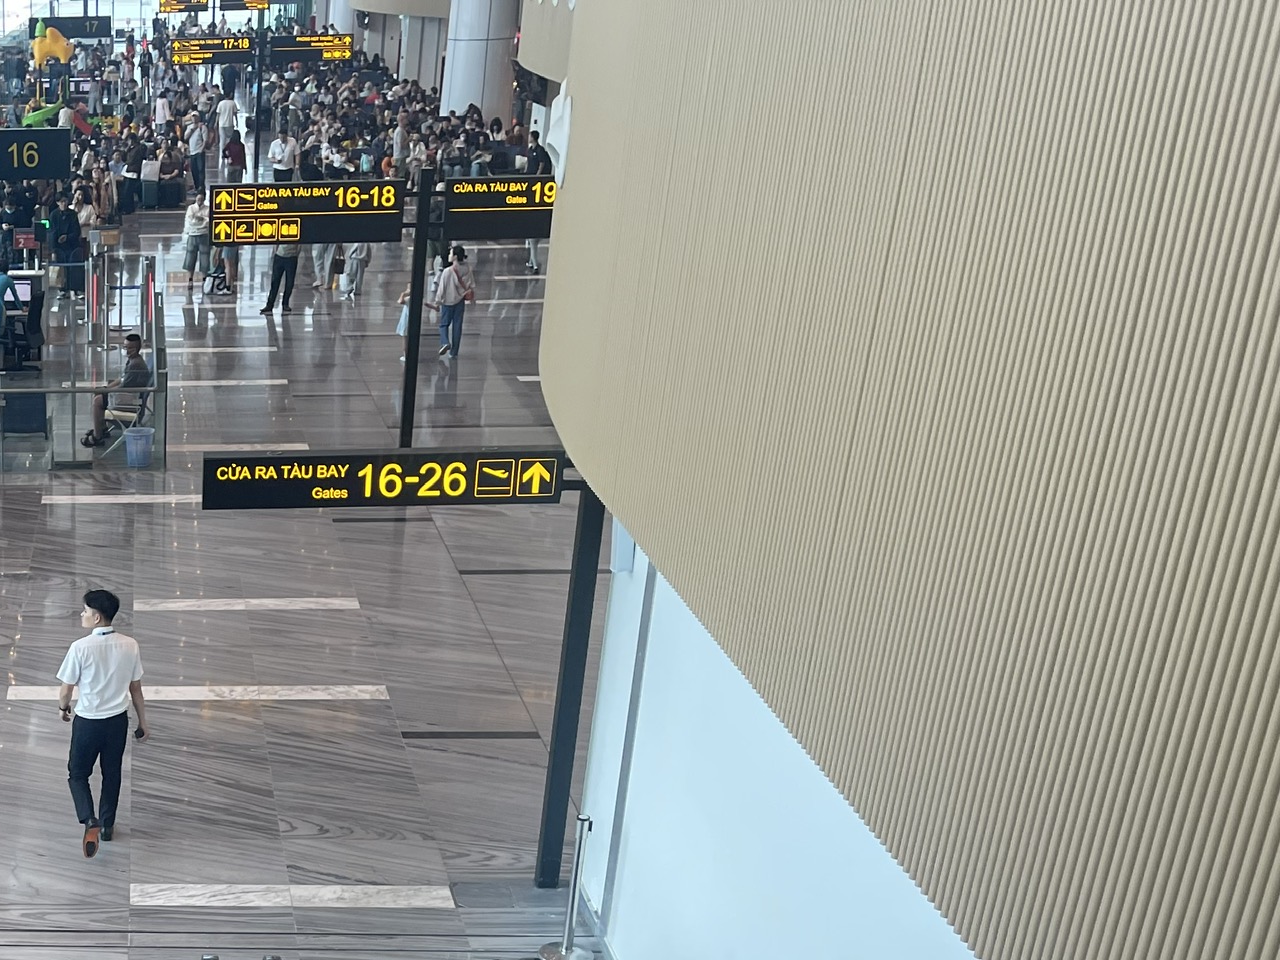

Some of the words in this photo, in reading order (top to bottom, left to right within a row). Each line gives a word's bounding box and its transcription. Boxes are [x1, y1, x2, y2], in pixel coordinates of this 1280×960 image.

[84, 20, 99, 33] 17
[222, 38, 250, 49] 17-18
[7, 141, 40, 168] 16
[257, 186, 280, 198] CỬA
[280, 188, 294, 198] RA
[294, 186, 312, 197] TÀU
[312, 187, 331, 197] BAY
[334, 185, 396, 208] 16-18
[453, 182, 473, 193] CỬA
[474, 183, 488, 192] RA
[489, 181, 508, 192] TÀU
[509, 182, 528, 192] BAY
[531, 181, 557, 203] 19
[257, 202, 279, 210] Gates
[216, 463, 254, 481] CỬA
[255, 466, 279, 480] RA
[281, 462, 316, 479] TÀU
[316, 464, 350, 479] BAY
[357, 461, 467, 498] 16-26
[311, 487, 348, 499] Gates
